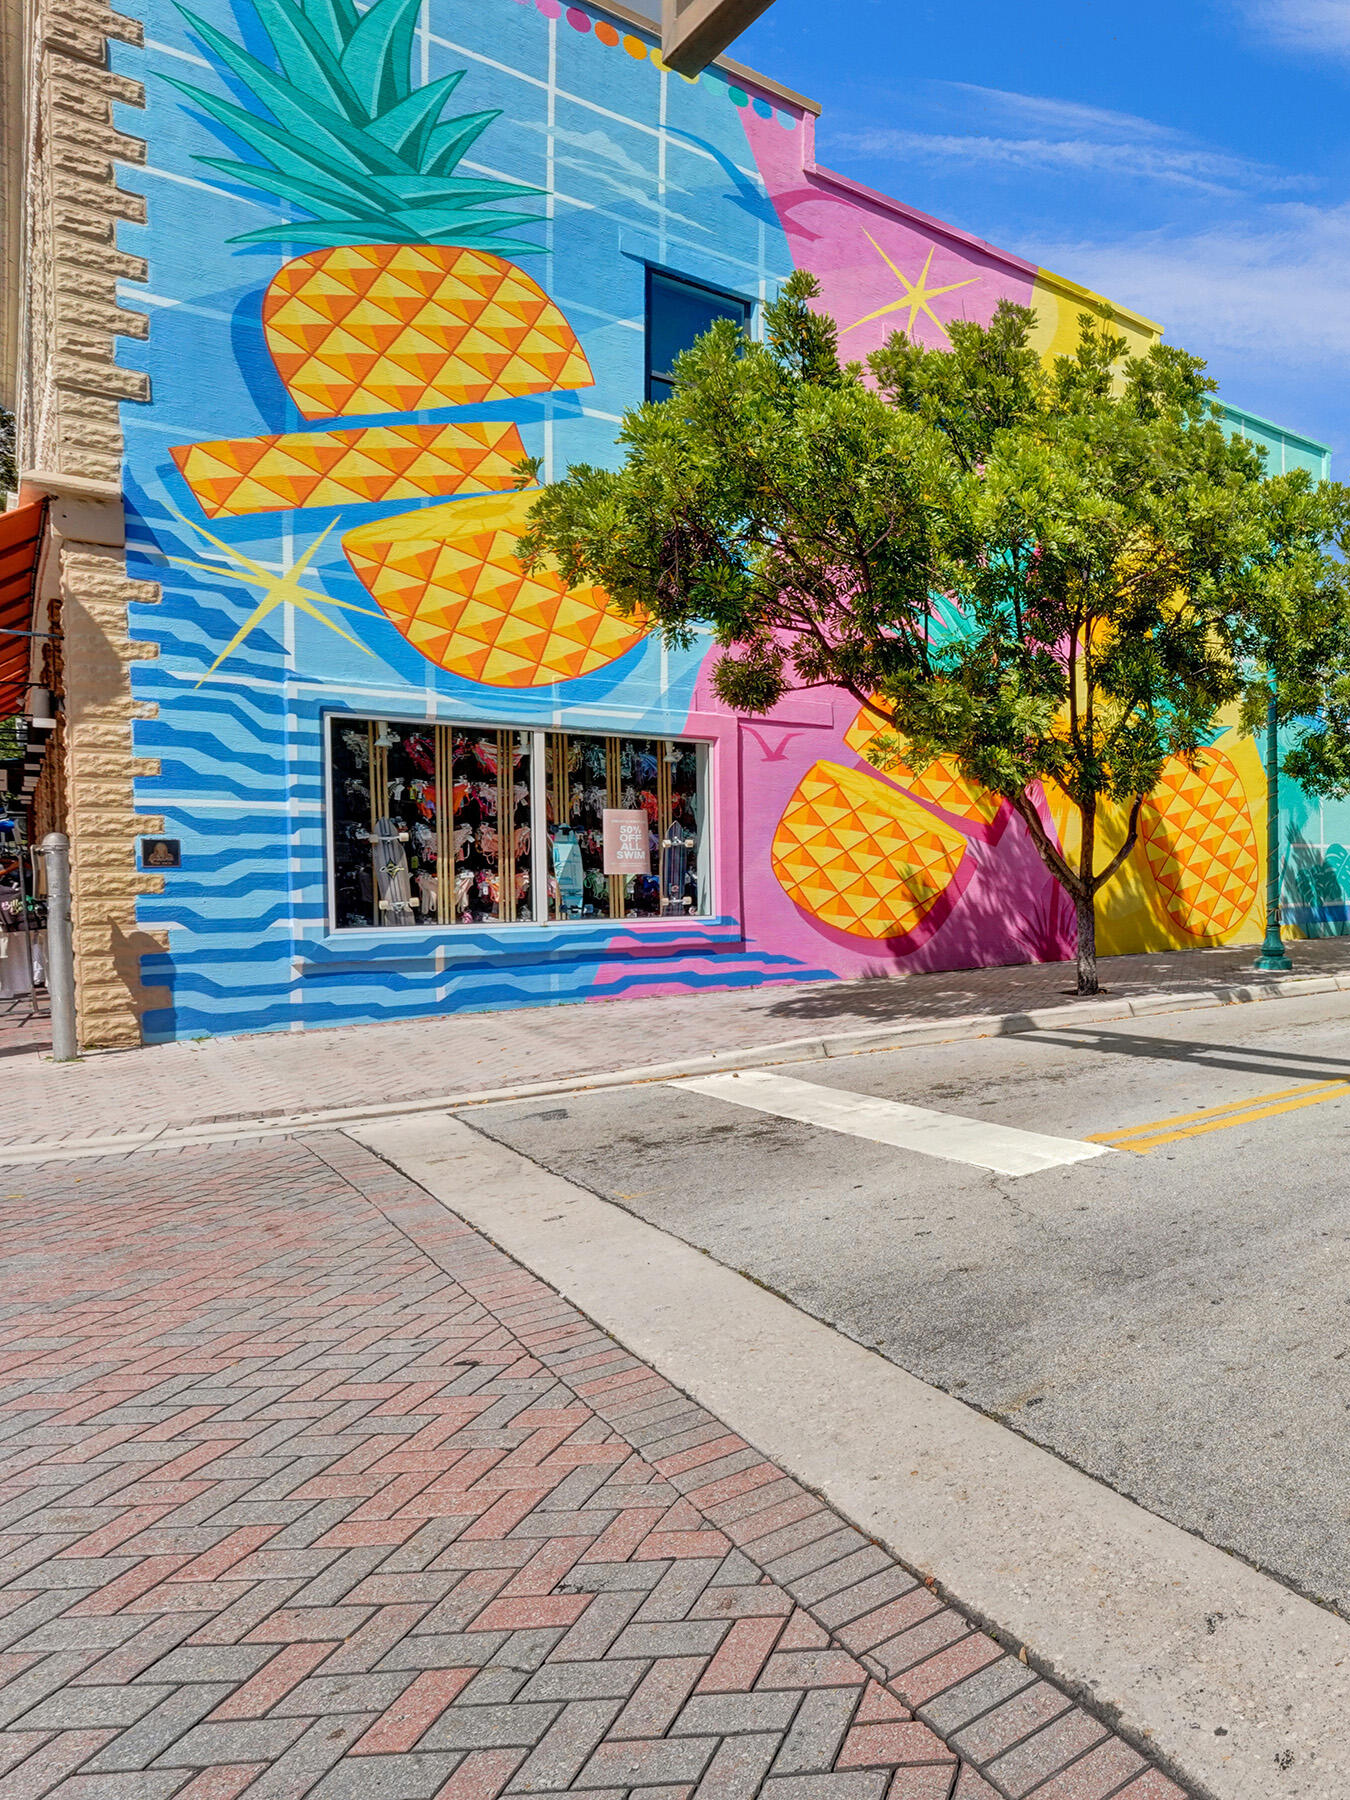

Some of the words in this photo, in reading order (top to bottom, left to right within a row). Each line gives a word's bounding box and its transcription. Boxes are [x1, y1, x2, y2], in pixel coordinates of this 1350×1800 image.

[619, 825, 641, 834] 50%
[619, 834, 642, 842] OFF
[620, 842, 642, 851] ALL
[616, 850, 646, 859] SWIM
